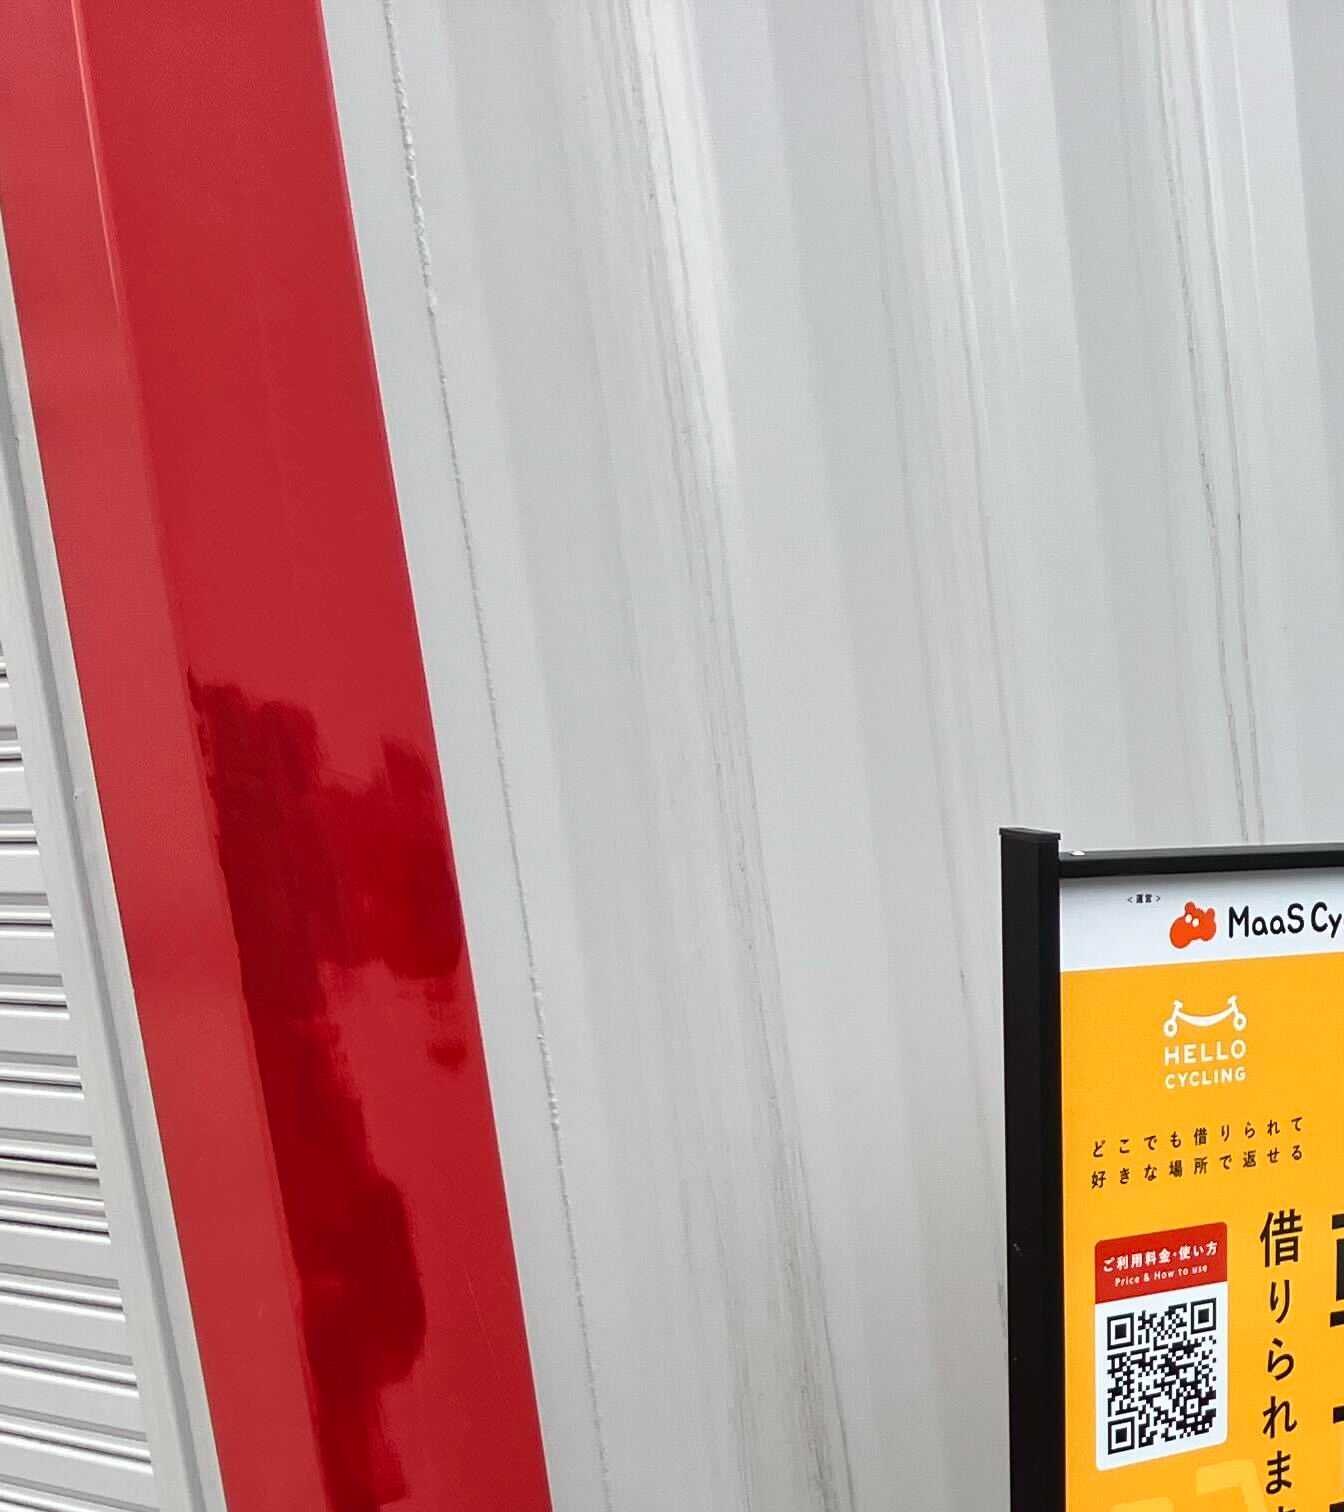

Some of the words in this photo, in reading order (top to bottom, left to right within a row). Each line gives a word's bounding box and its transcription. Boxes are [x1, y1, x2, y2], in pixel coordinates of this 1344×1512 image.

[1228, 902, 1304, 938] MaaS
[1163, 1038, 1247, 1066] HELLO
[1164, 1066, 1247, 1089] CYCLING
[1091, 1116, 1304, 1158] どこでも借りられて
[1091, 1144, 1303, 1189] 好きな場所で返せる
[1114, 1276, 1140, 1288] Price
[1143, 1273, 1150, 1283] &
[1154, 1270, 1175, 1280] How
[1191, 1264, 1208, 1275] use
